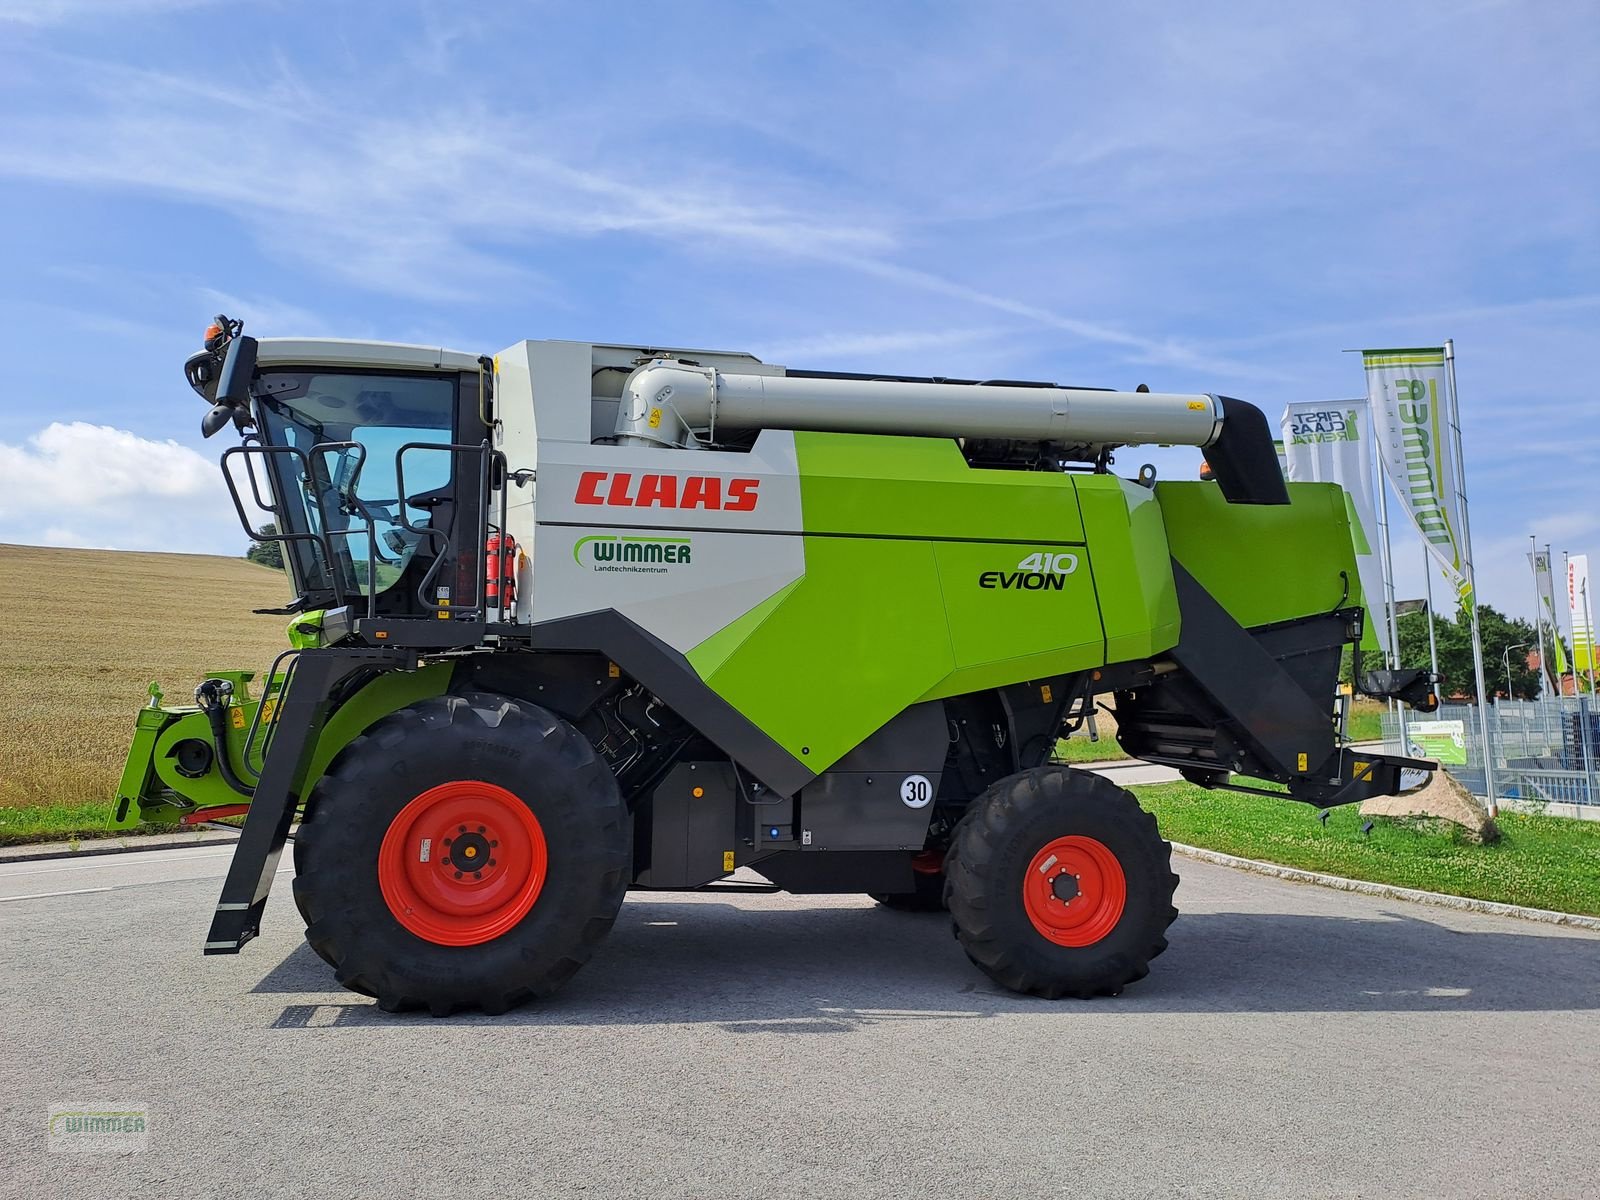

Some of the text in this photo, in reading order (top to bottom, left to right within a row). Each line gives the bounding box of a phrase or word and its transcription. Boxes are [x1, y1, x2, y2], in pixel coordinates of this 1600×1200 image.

[575, 471, 760, 512] CLAAS
[593, 542, 691, 564] WIMMER
[1018, 552, 1078, 575] 410
[593, 565, 668, 574] Landtechnikzentrum
[978, 571, 1066, 591] EVION
[905, 781, 927, 802] 30
